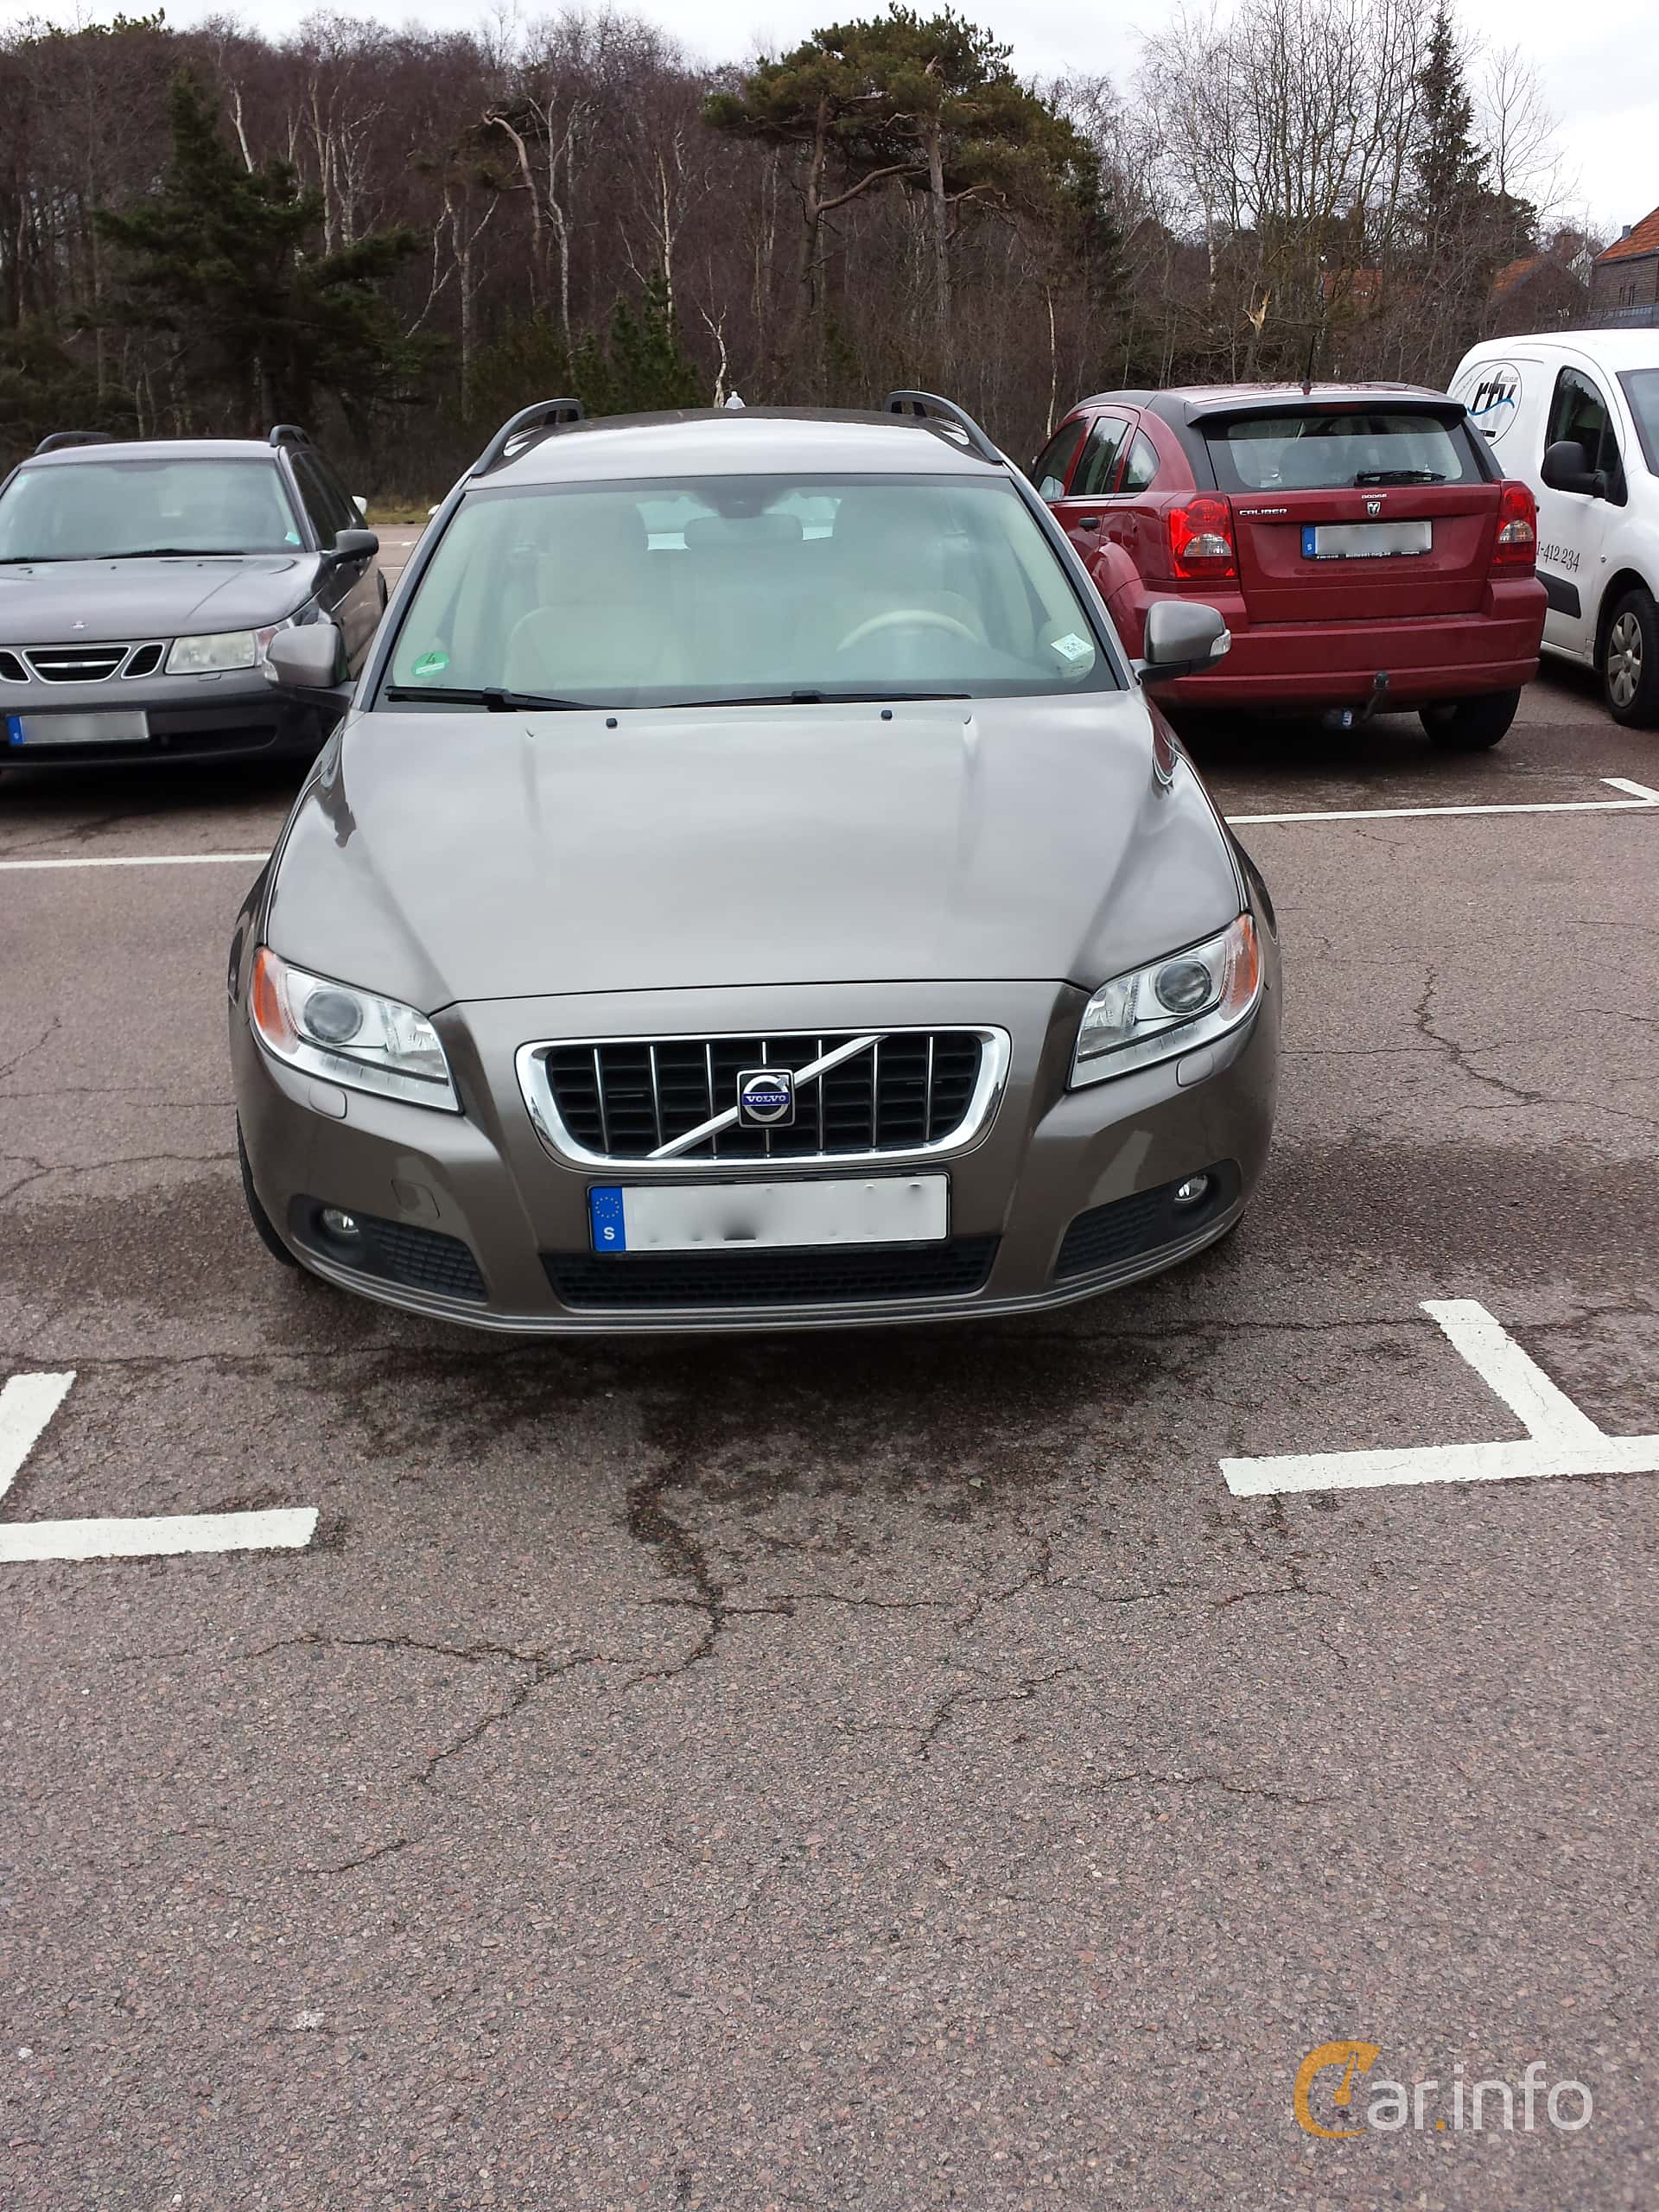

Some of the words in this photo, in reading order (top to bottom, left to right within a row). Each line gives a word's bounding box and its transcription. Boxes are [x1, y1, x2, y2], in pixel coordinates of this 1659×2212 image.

[1560, 548, 1580, 572] 234
[425, 652, 435, 664] 4
[603, 1227, 614, 1240] S
